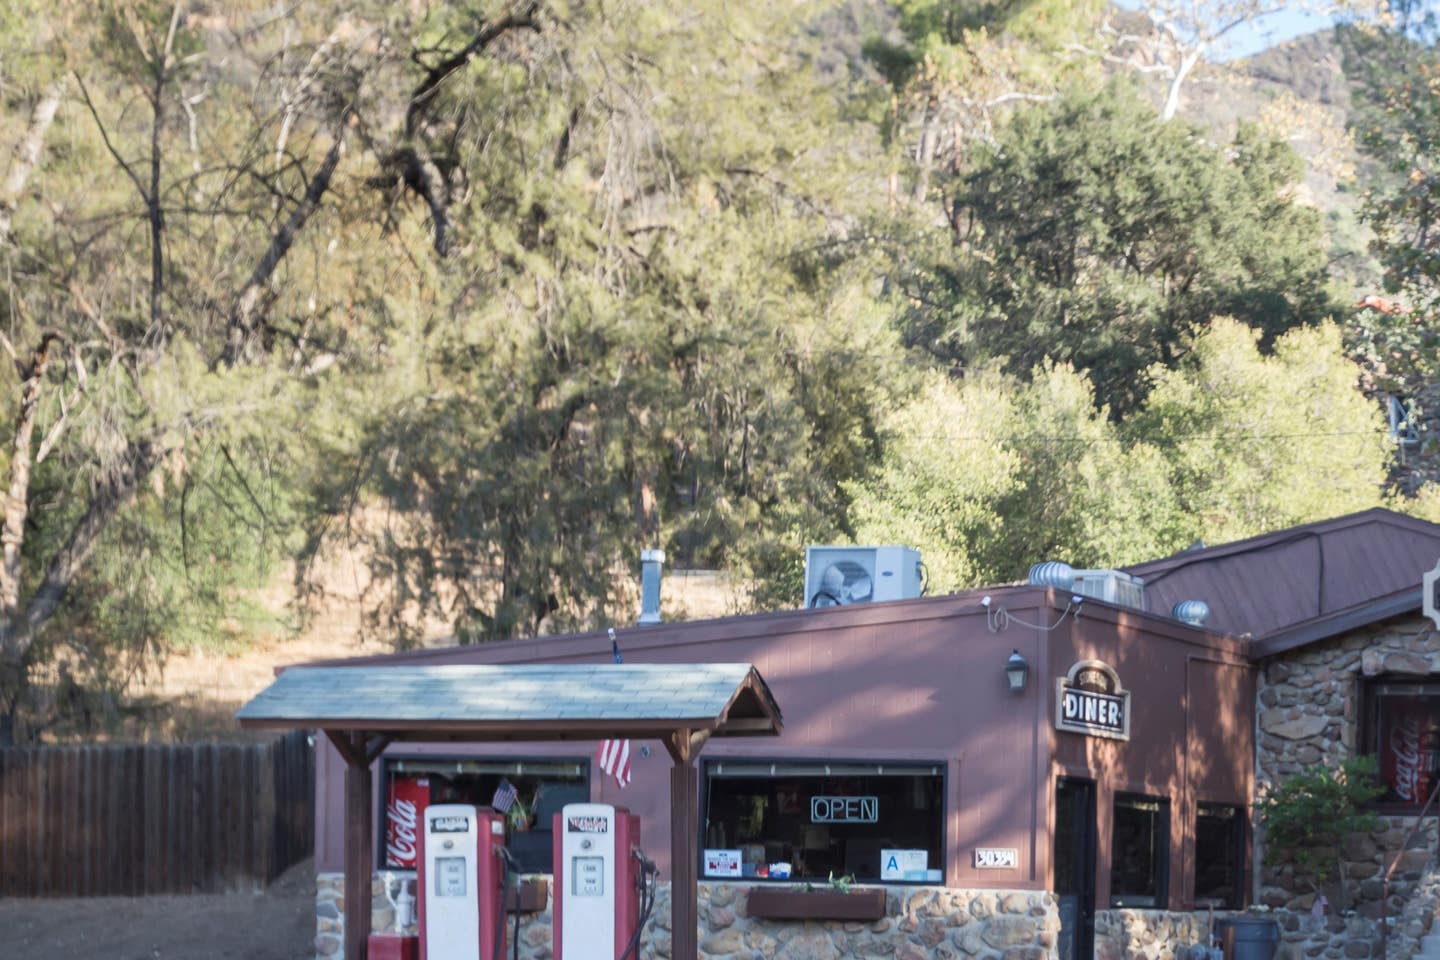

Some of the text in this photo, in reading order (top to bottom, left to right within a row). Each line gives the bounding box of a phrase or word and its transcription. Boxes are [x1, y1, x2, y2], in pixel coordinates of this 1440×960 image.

[1065, 693, 1119, 726] DINER
[814, 798, 875, 821] OPEN
[386, 798, 417, 861] Cola
[886, 855, 898, 871] A
